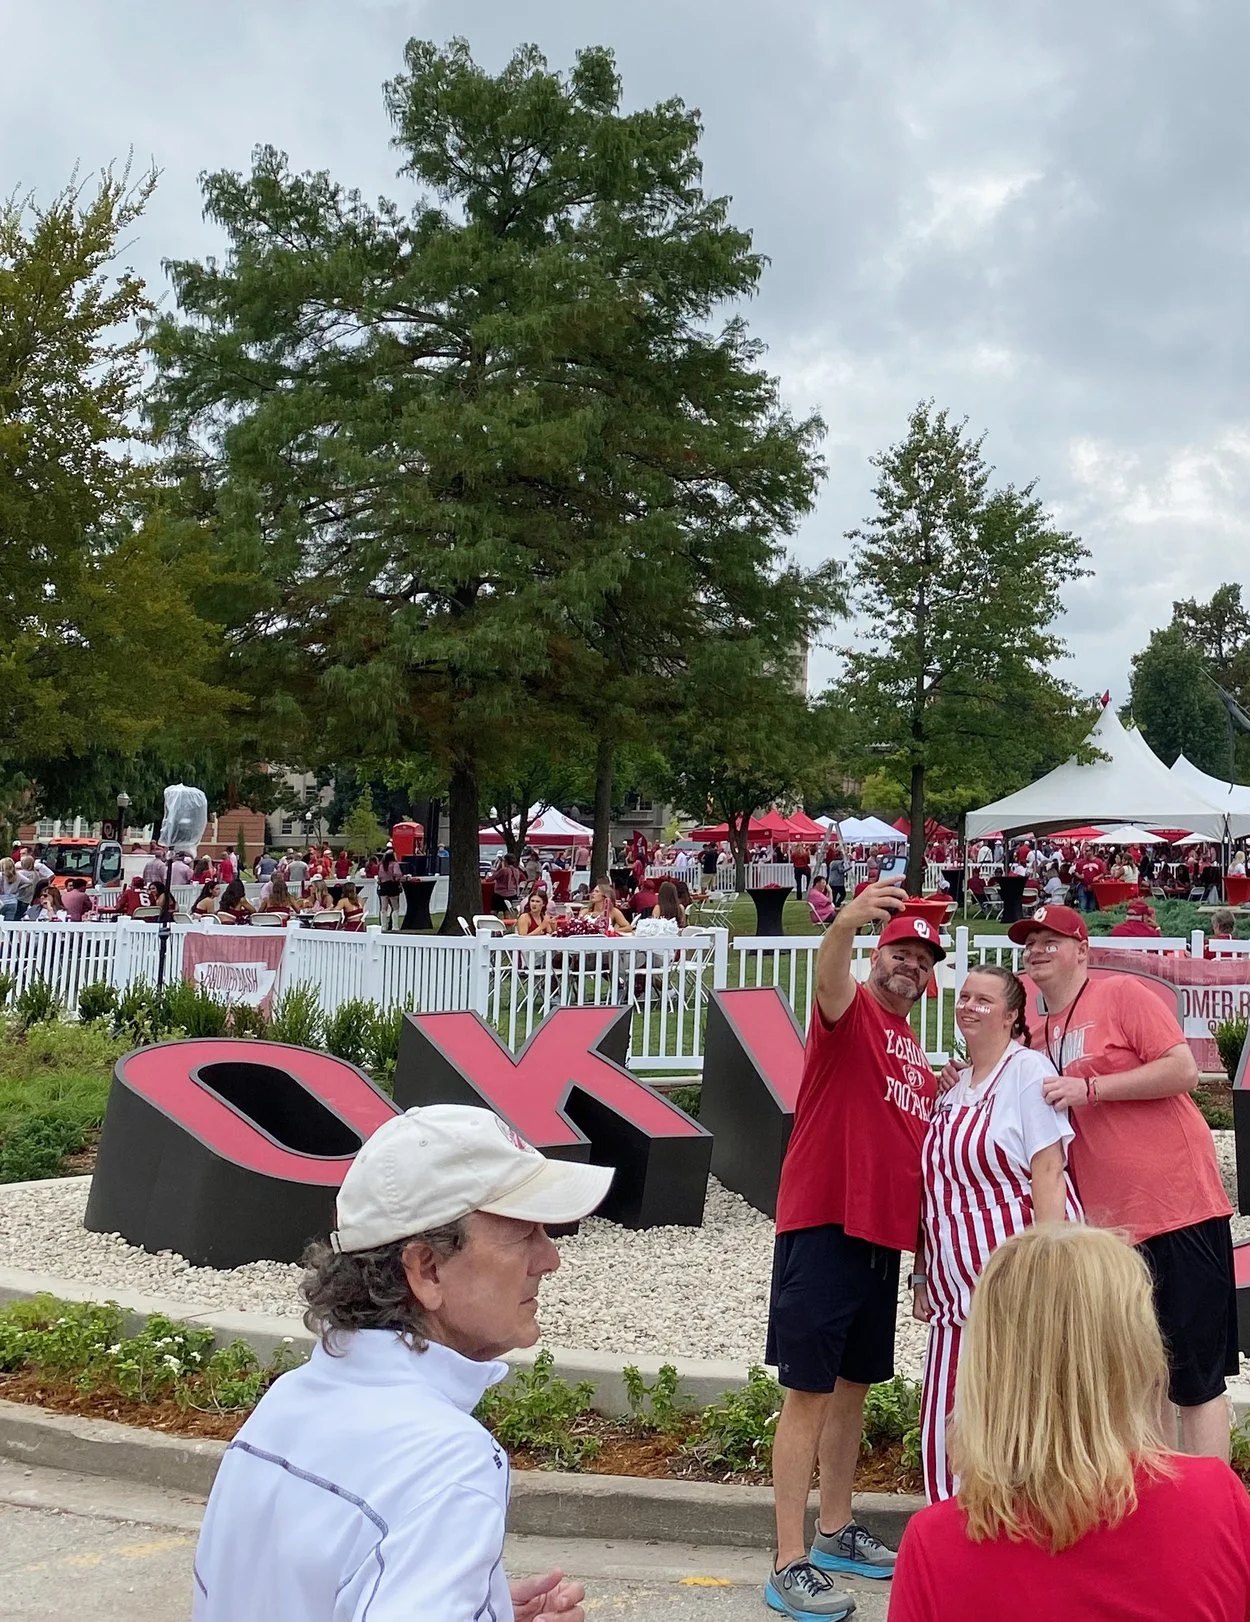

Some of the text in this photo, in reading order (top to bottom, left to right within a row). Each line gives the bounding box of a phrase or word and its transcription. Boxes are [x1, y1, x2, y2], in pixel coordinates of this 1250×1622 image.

[104, 823, 114, 838] OU
[140, 893, 151, 906] 6
[913, 919, 930, 939] OU
[1184, 988, 1233, 1020] OMER
